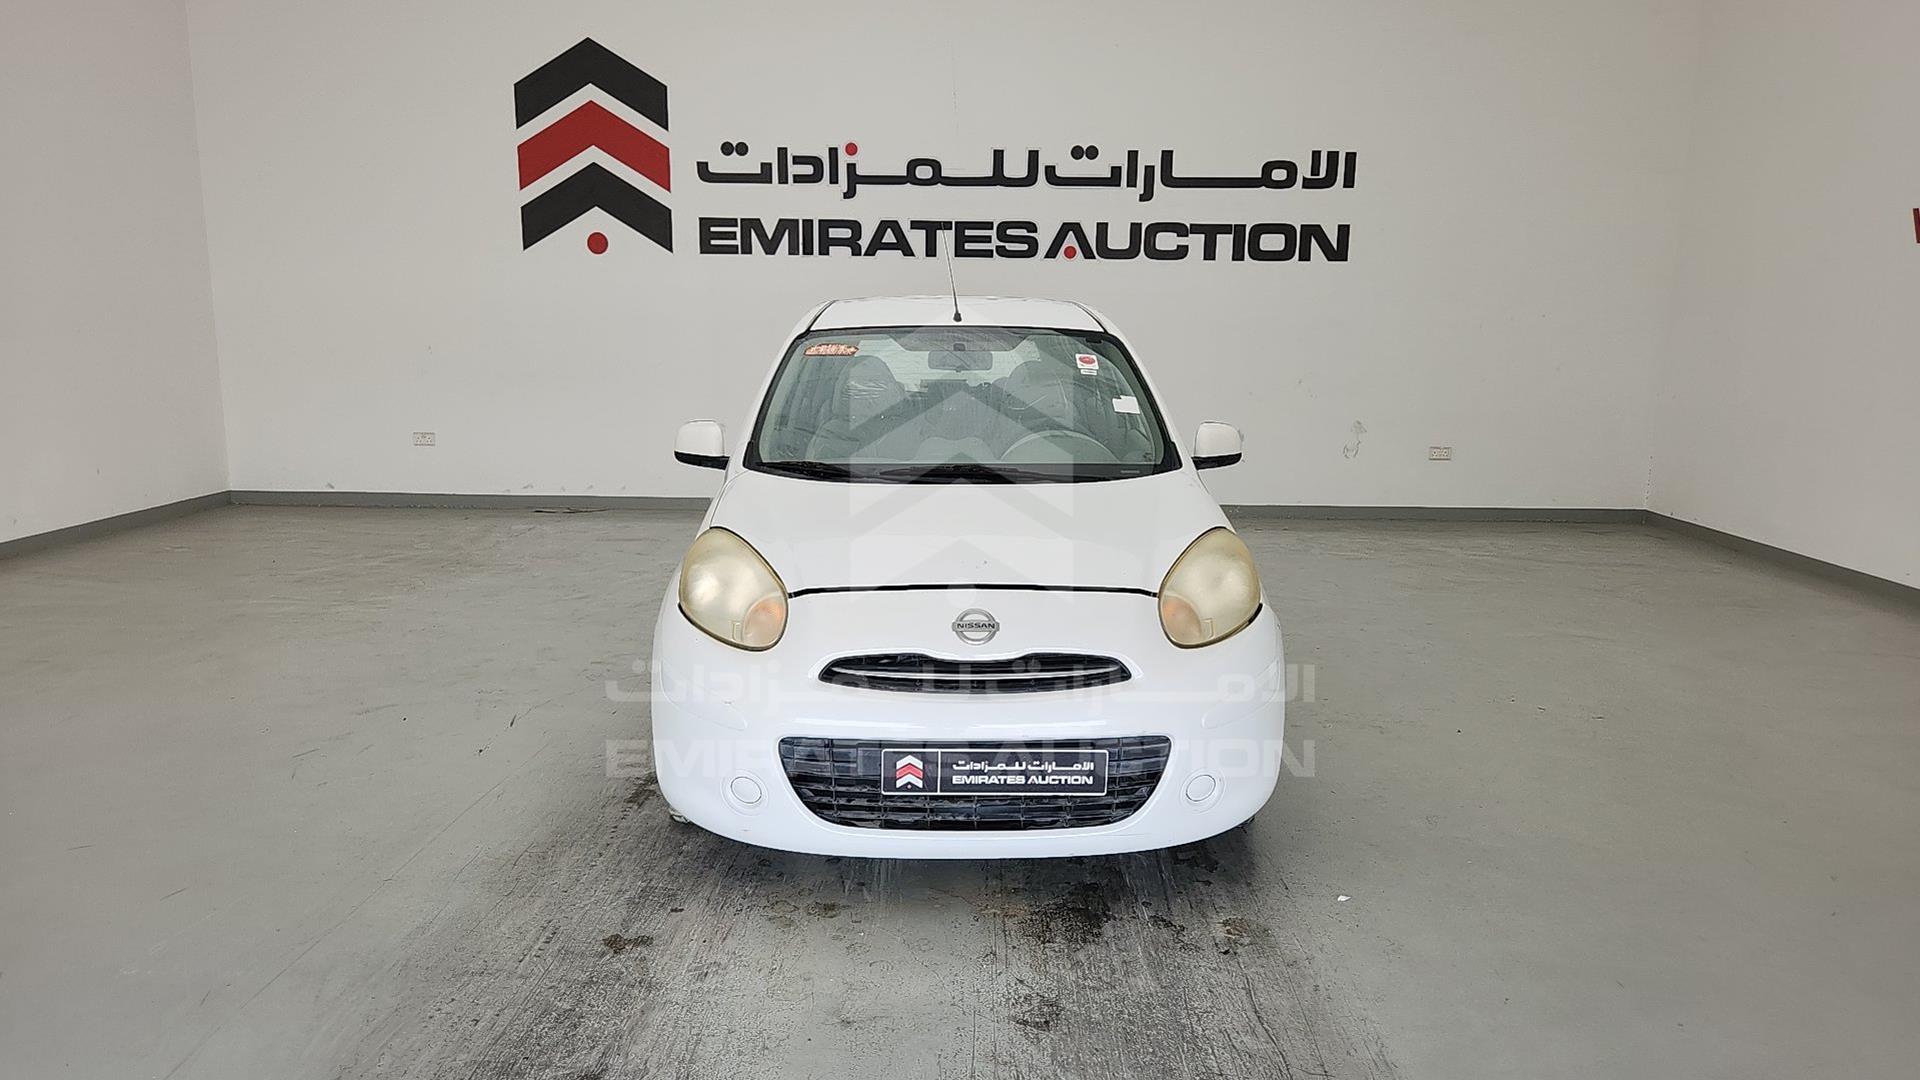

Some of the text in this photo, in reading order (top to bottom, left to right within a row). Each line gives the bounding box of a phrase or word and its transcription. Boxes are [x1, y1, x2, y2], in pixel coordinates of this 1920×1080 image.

[696, 141, 1040, 200] للمزادات
[698, 216, 1351, 262] EMIRATES AUCTION
[952, 775, 1094, 785] EMIRATES AUCTION
